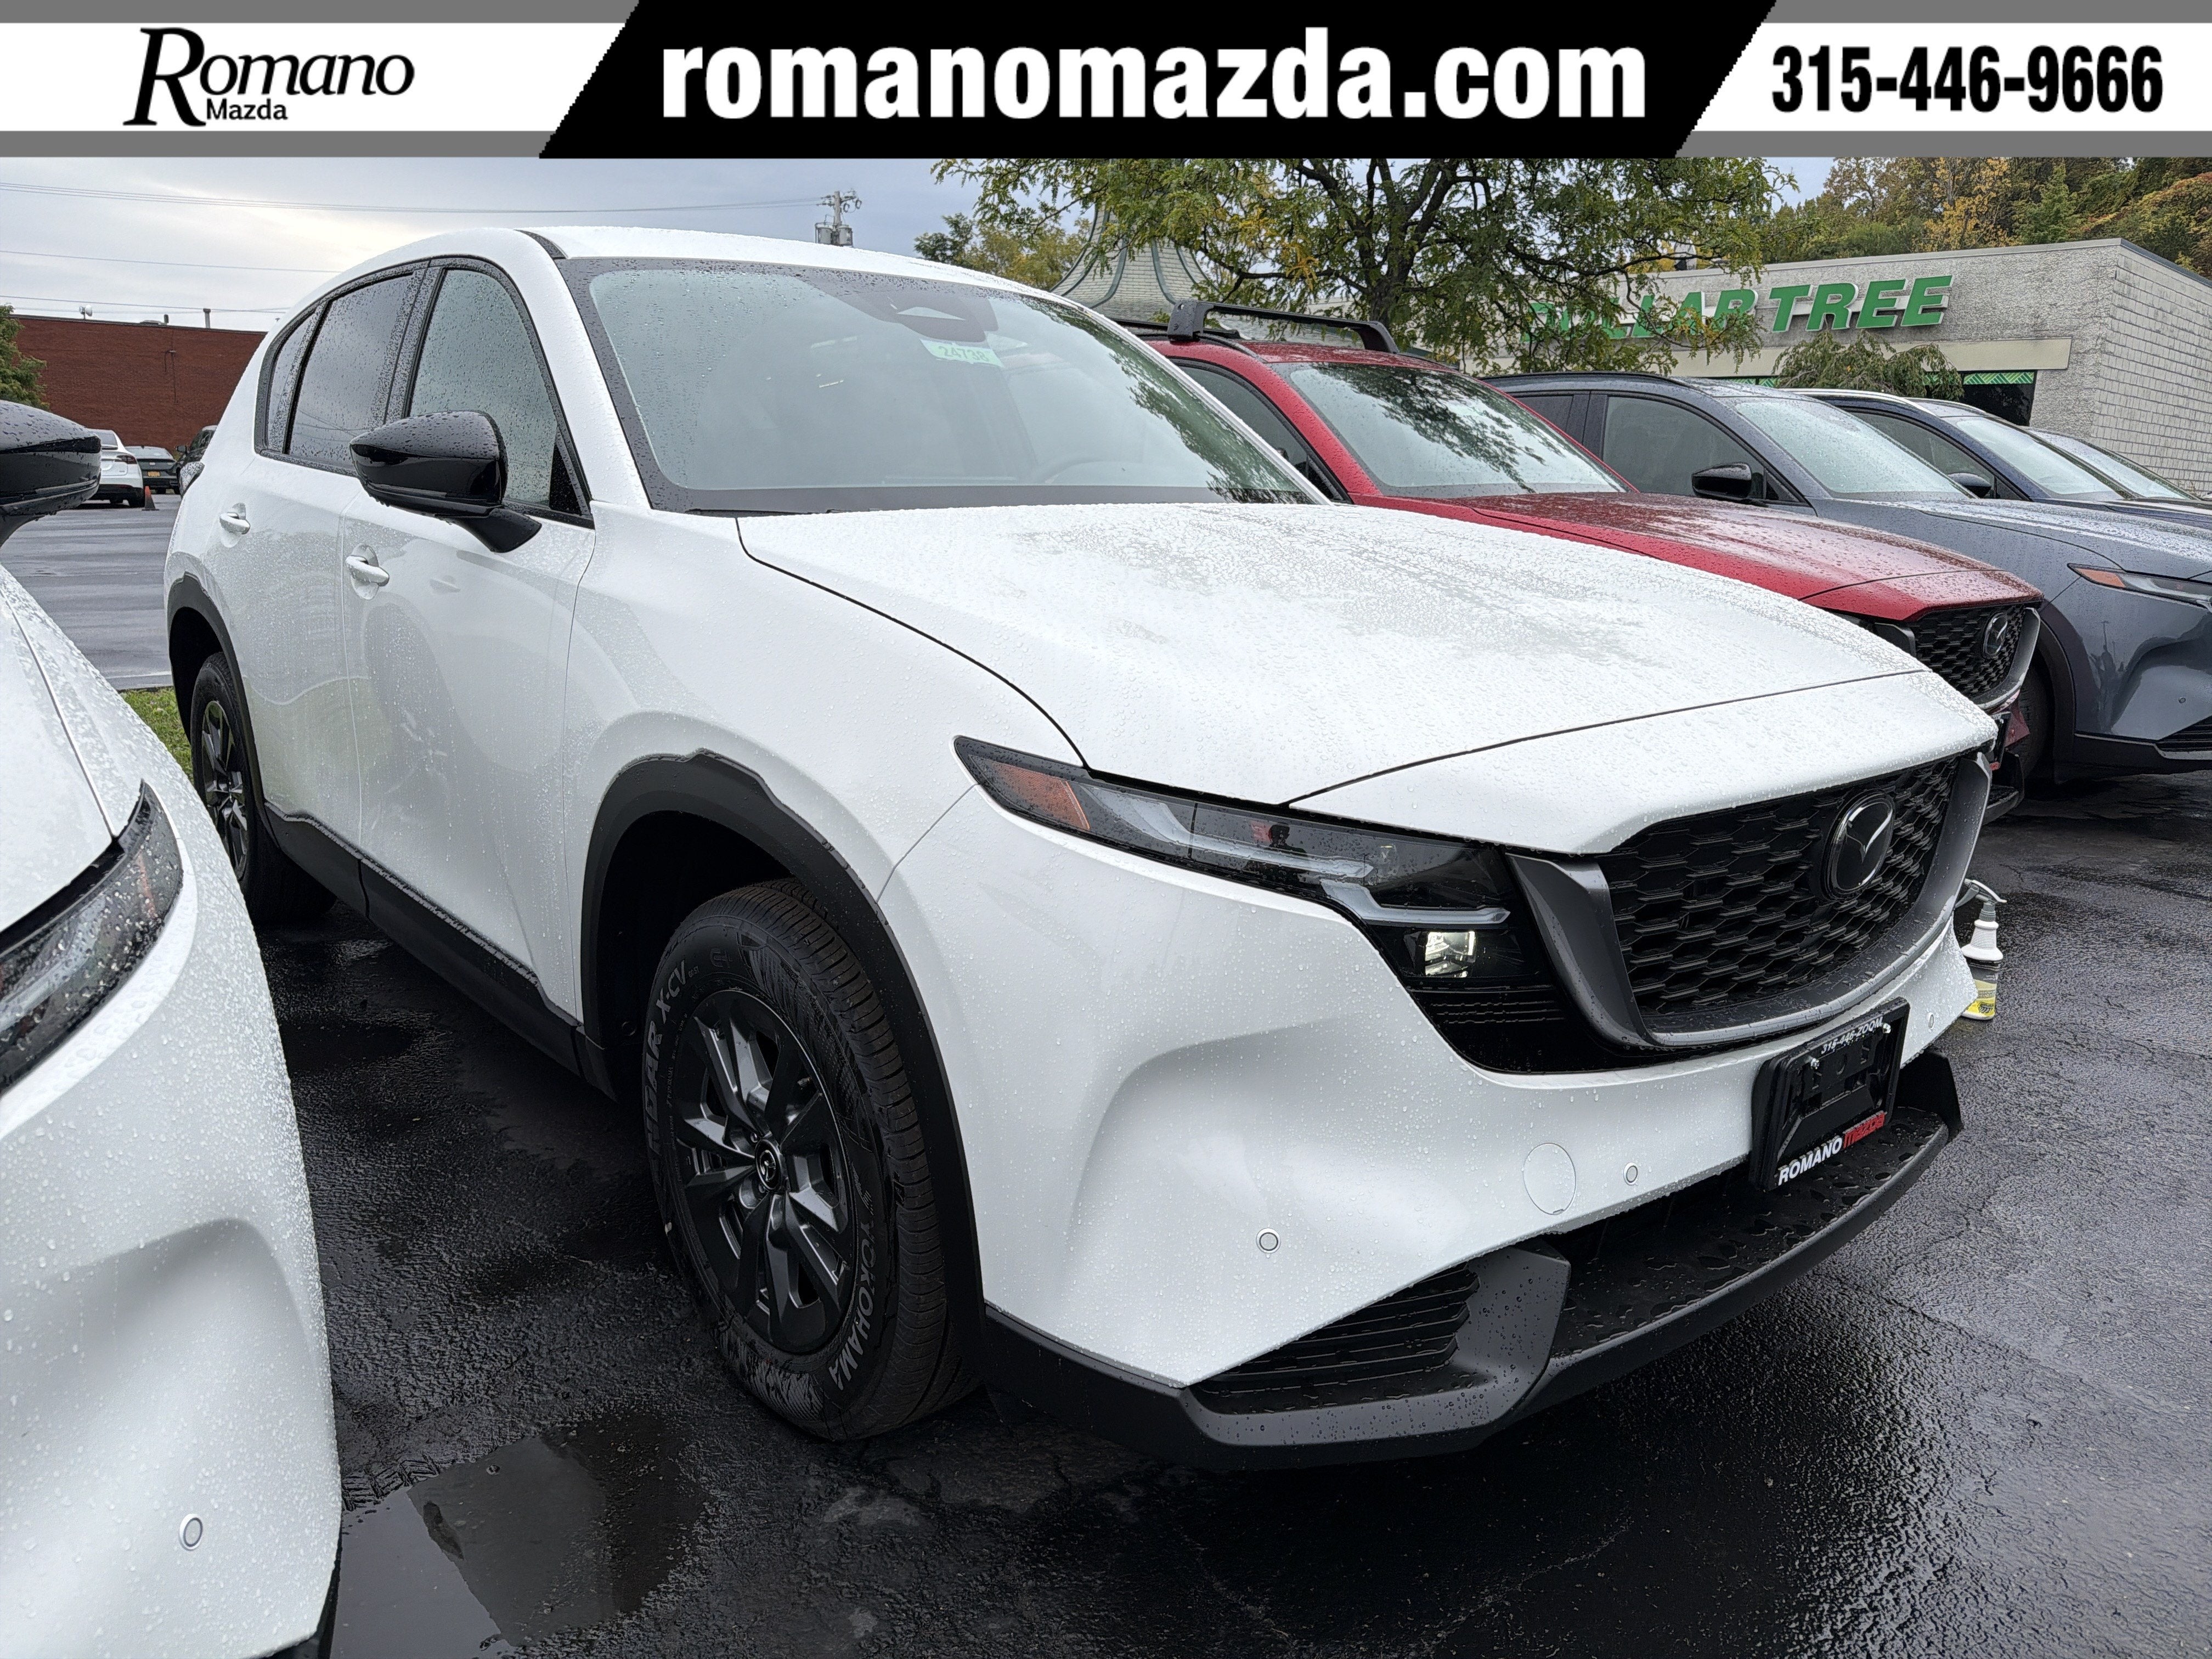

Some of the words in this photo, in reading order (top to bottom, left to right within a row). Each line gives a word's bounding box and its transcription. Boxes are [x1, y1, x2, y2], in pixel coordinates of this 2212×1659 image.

[1769, 275, 1953, 333] TREE
[1820, 1016, 1883, 1055] 315-446-ZOOM
[1778, 1136, 1843, 1186] ROMANO
[828, 1220, 876, 1391] YOKOHAMA
